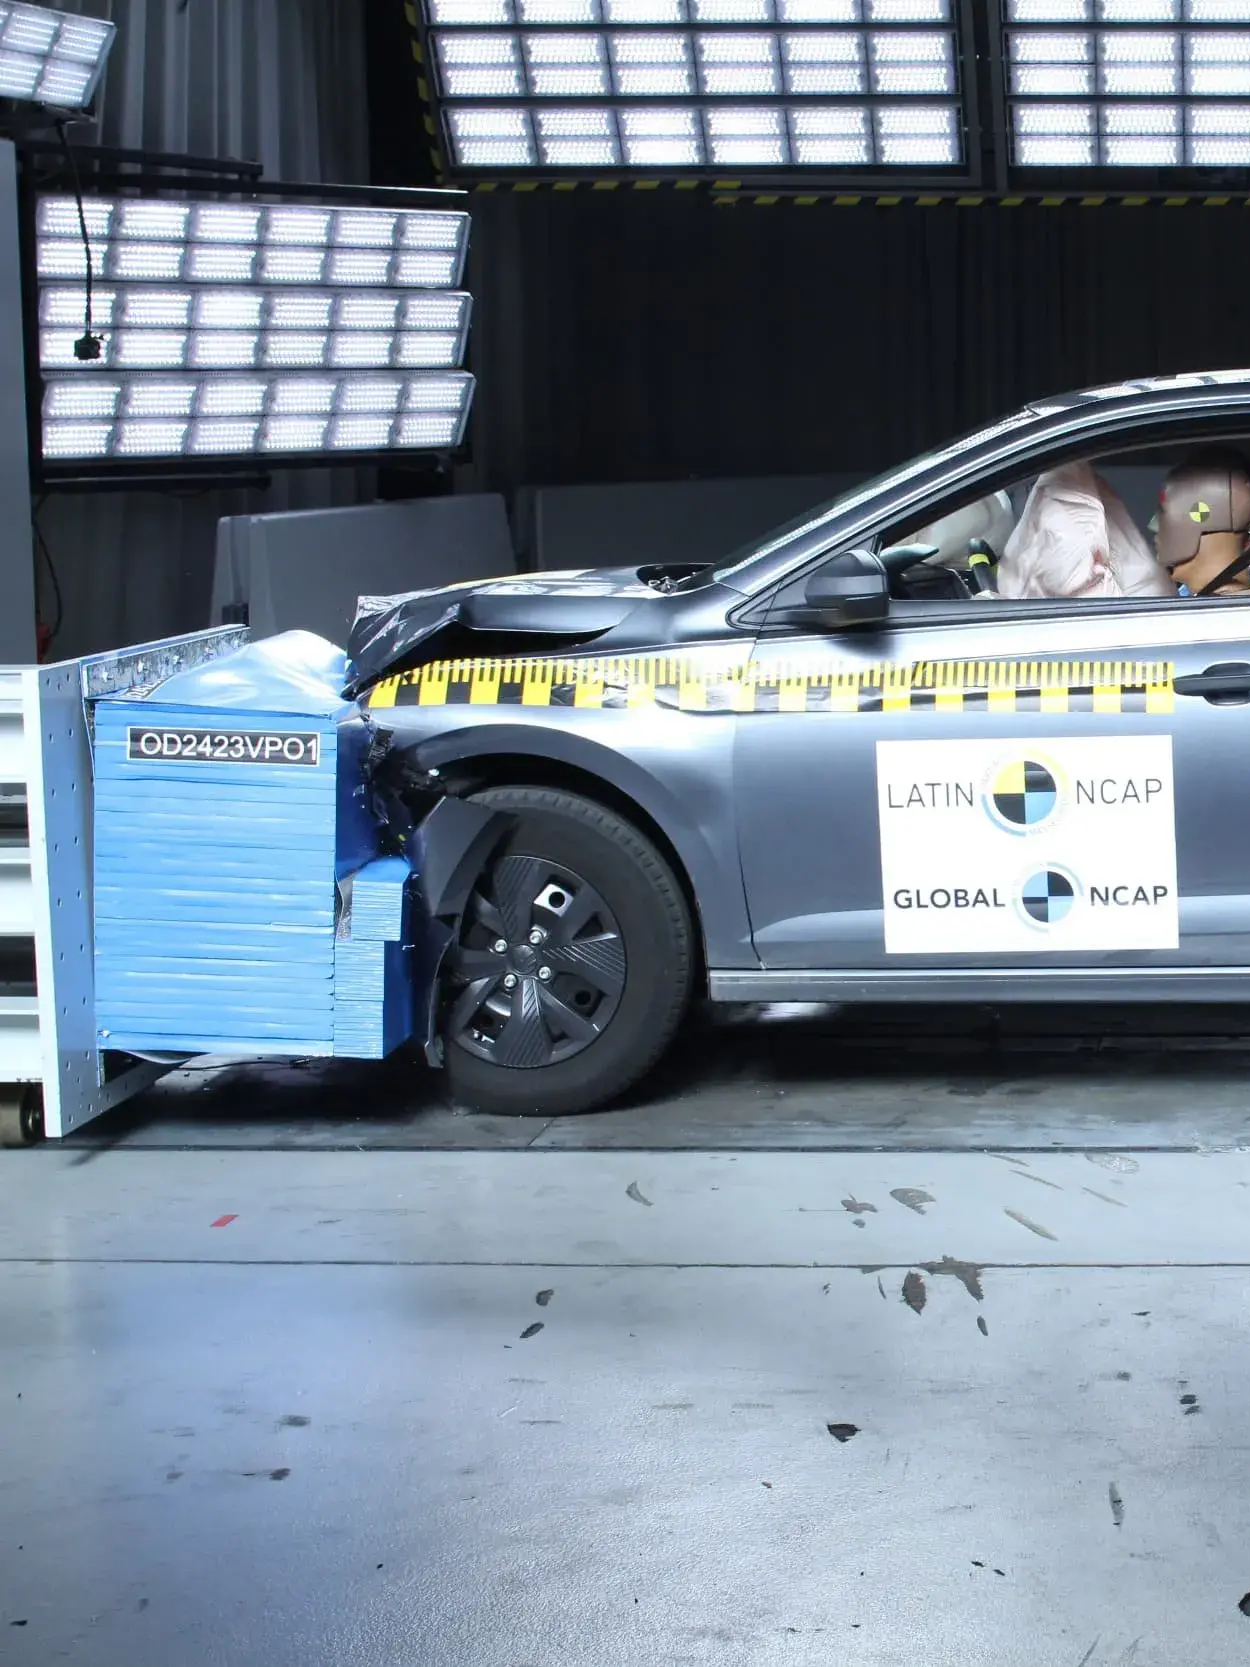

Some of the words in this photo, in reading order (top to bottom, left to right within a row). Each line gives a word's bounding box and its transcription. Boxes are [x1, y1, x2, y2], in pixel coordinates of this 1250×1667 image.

[888, 782, 974, 809] LATIN
[1076, 778, 1163, 805] NCAP
[893, 888, 1006, 909] GLOBAL
[1089, 885, 1169, 906] NCAP
